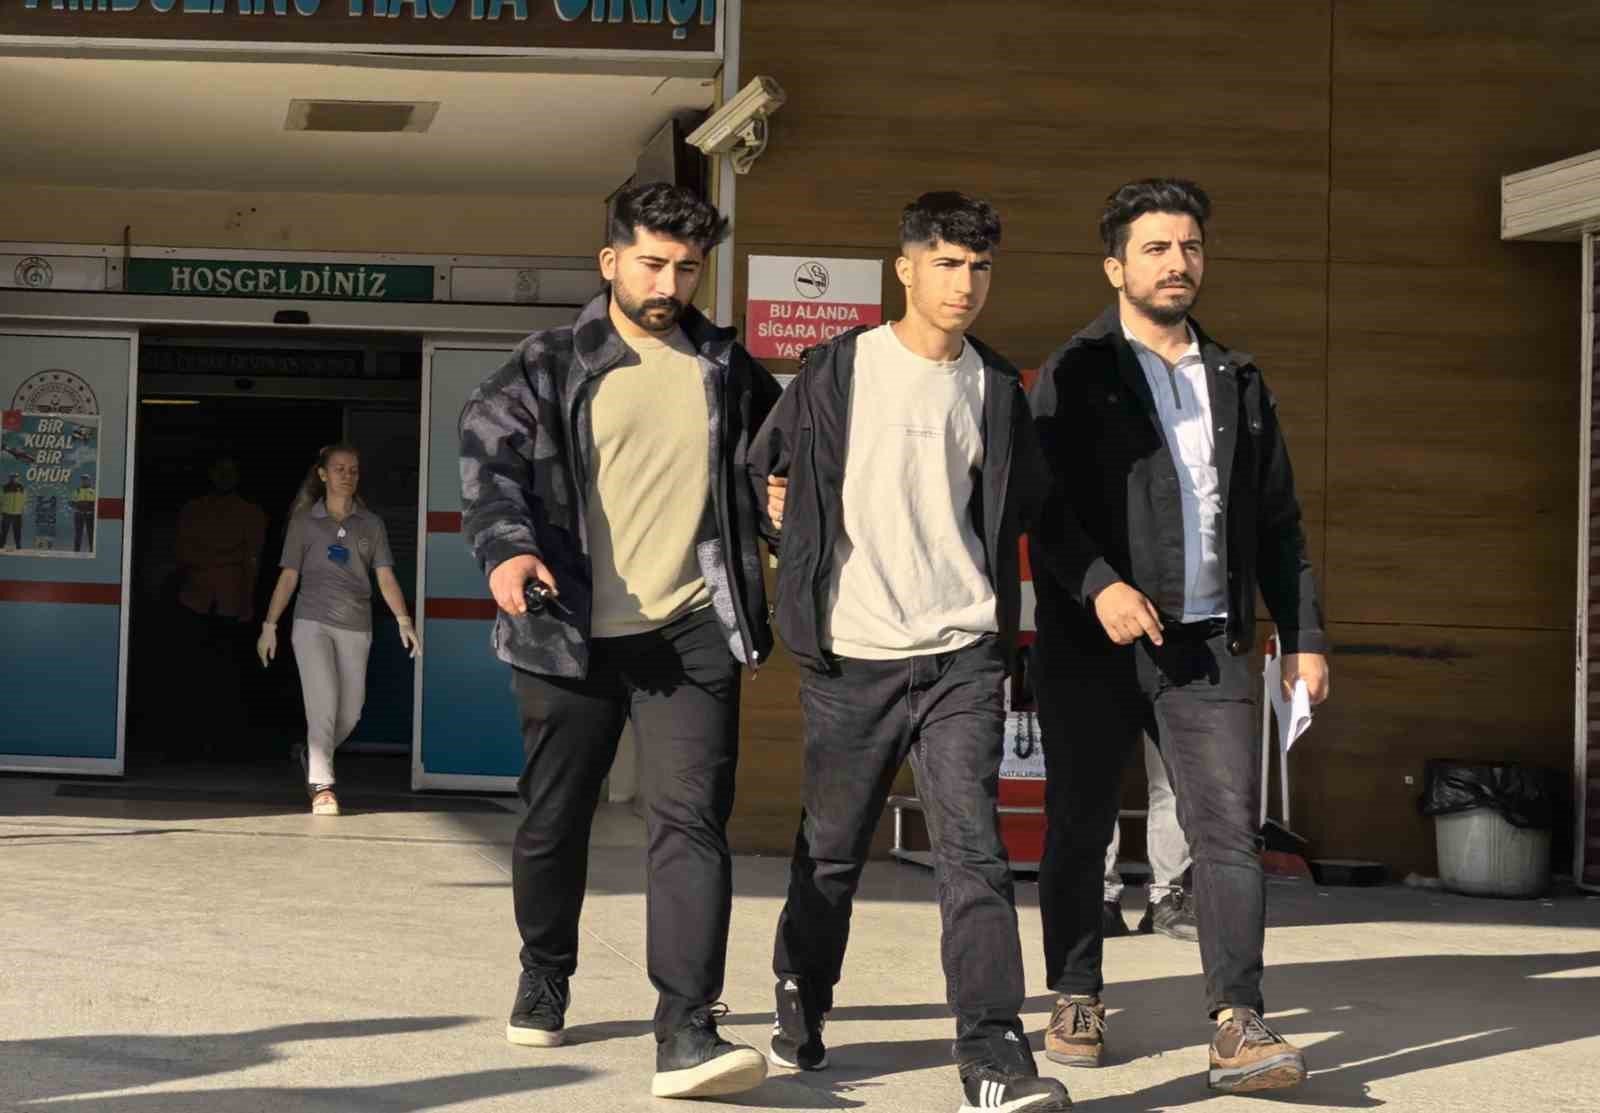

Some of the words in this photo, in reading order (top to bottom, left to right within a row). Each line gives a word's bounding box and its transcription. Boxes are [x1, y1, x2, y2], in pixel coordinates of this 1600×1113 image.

[770, 303, 792, 319] BU
[795, 305, 859, 321] ALANDA
[758, 320, 816, 338] SİGARA
[24, 432, 73, 449] KURAL
[26, 465, 72, 483] ÖMÜR
